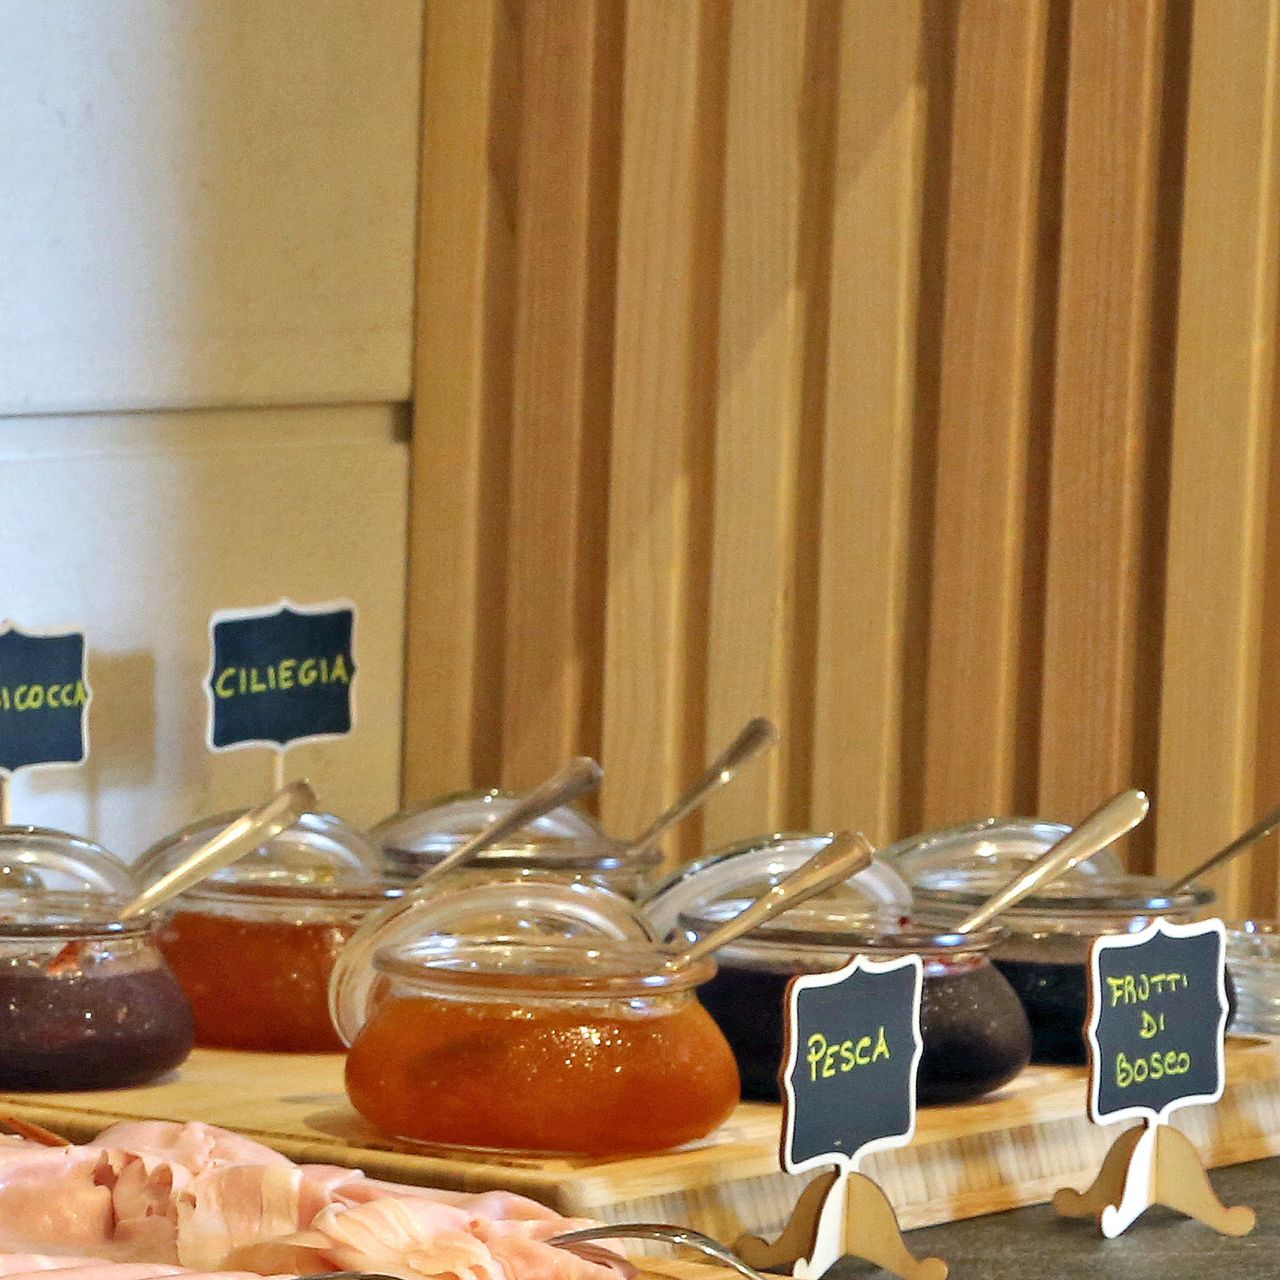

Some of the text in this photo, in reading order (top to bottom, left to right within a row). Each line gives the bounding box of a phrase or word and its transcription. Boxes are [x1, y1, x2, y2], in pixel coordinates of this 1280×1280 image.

[215, 654, 348, 698] CILIEGIA
[1107, 972, 1188, 1006] FRUTTI
[1139, 1010, 1165, 1039] DI
[806, 1027, 891, 1081] PESCA
[1115, 1049, 1191, 1088] BOSCO
